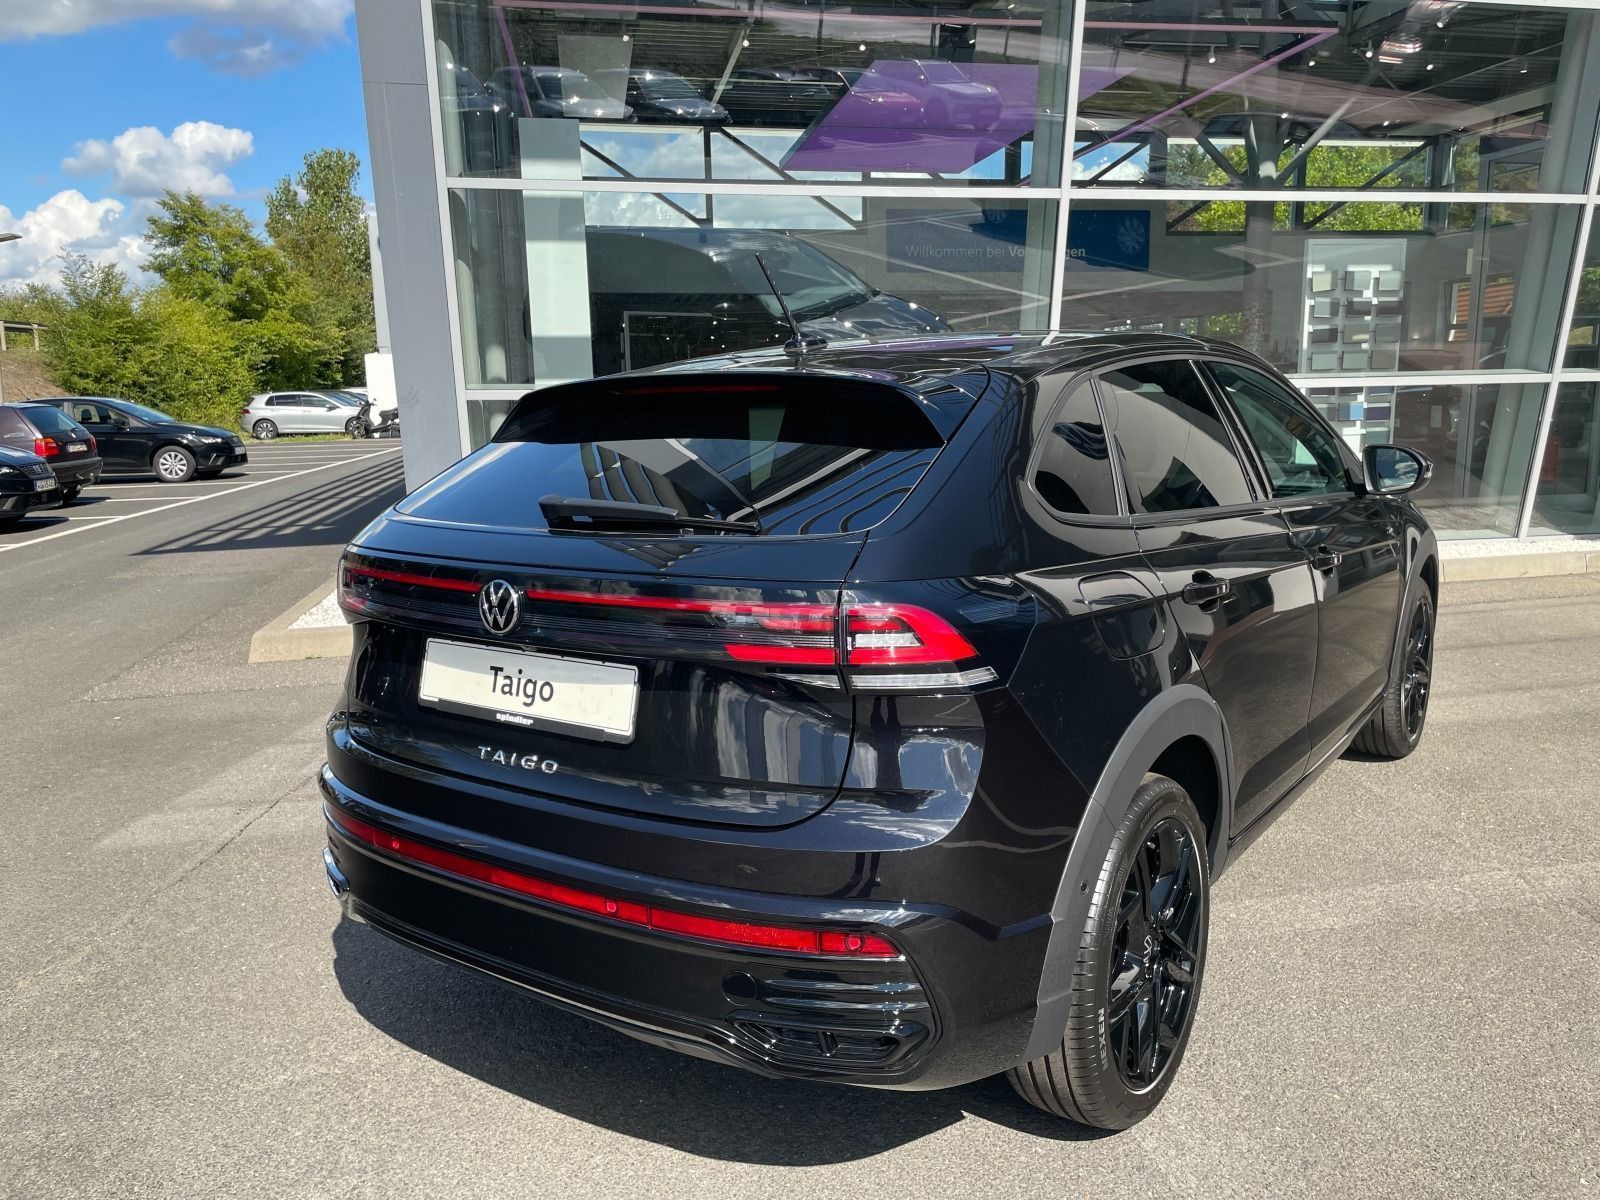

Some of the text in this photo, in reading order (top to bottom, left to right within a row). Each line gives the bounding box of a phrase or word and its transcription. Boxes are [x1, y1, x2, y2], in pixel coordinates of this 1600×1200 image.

[906, 245, 983, 257] Willkommen
[986, 245, 1005, 257] bei
[489, 665, 554, 707] Taigo
[495, 712, 534, 726] spindler
[478, 745, 559, 774] TAIGO
[1097, 1007, 1109, 1072] NEXEN
